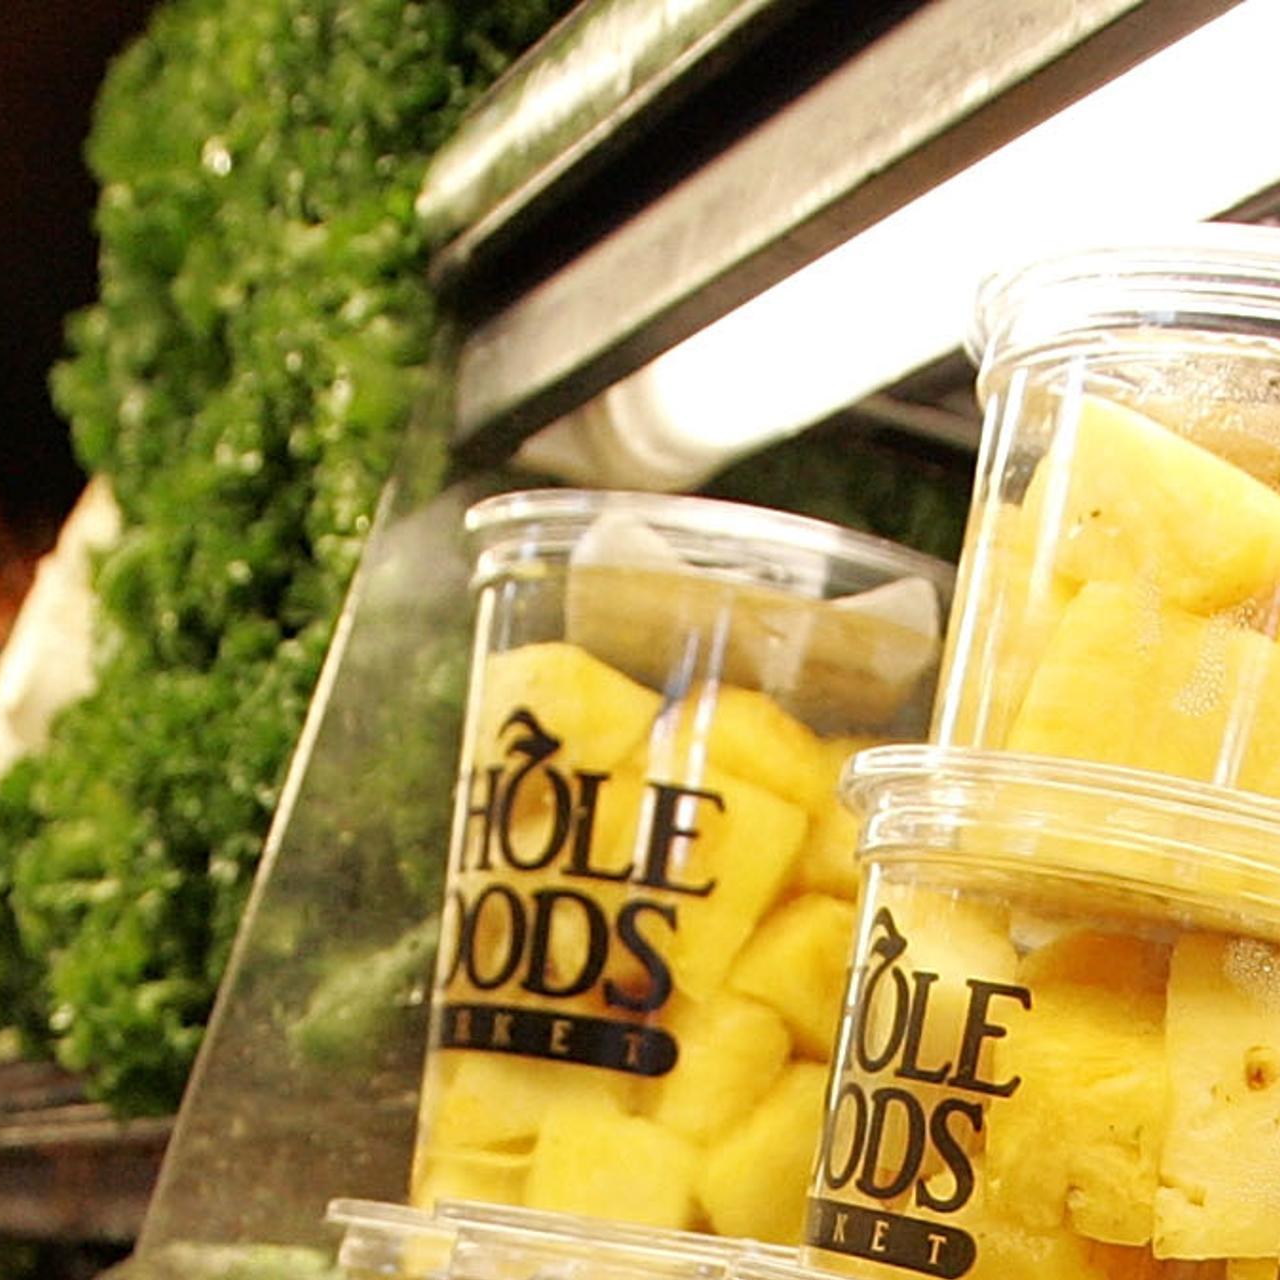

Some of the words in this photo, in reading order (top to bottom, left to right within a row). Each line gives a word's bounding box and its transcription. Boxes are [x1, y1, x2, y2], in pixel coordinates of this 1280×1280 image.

[448, 762, 726, 898] HOLE
[453, 1010, 644, 1068] RKET
[824, 1082, 983, 1214] ODS
[832, 1212, 948, 1266] KET
